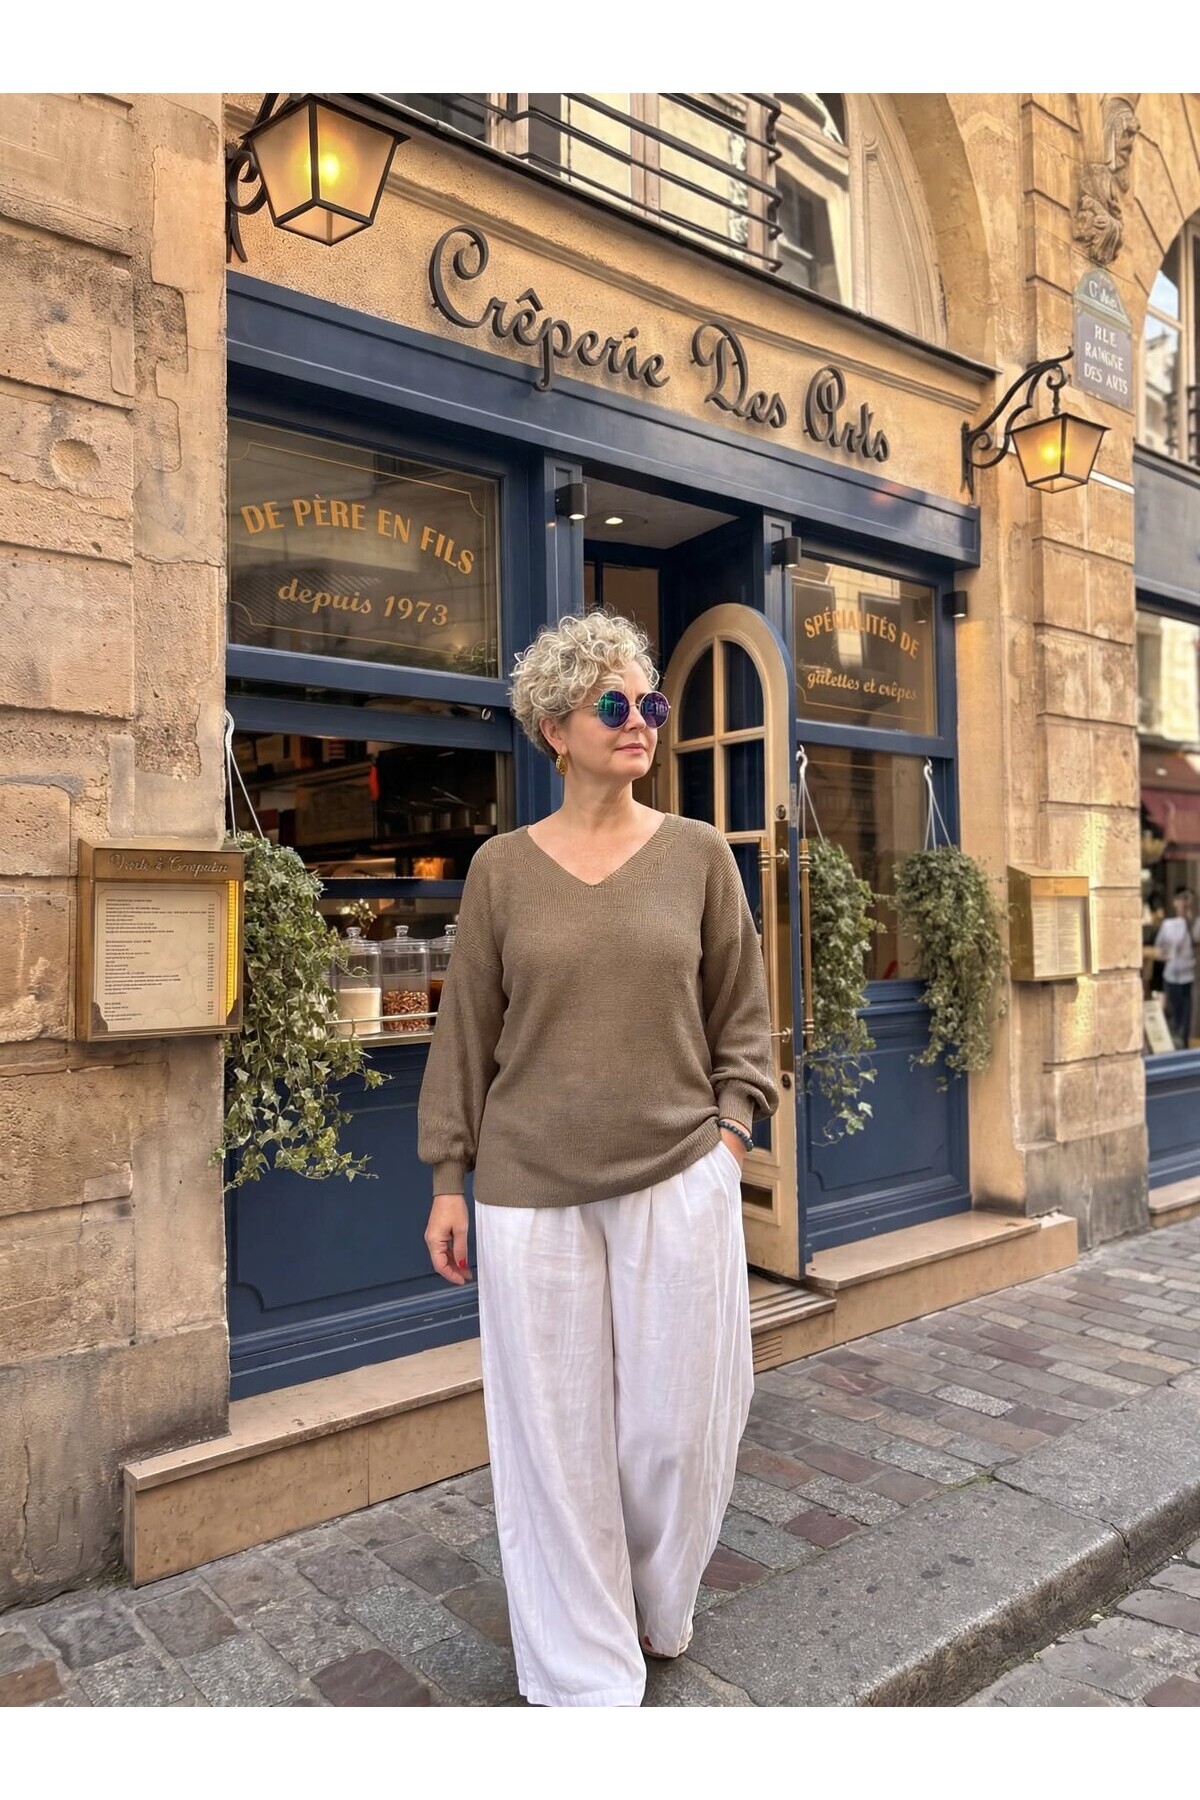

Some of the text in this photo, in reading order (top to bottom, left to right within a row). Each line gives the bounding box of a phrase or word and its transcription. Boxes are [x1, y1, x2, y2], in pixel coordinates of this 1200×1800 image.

[429, 224, 890, 463] Crêperie Des Arts
[240, 494, 475, 575] DE PÈRE EN FILS
[278, 578, 449, 627] depuis 1973
[804, 606, 920, 660] SPÉCIALITÉS DE
[863, 678, 877, 693] et
[879, 681, 917, 703] crêpes
